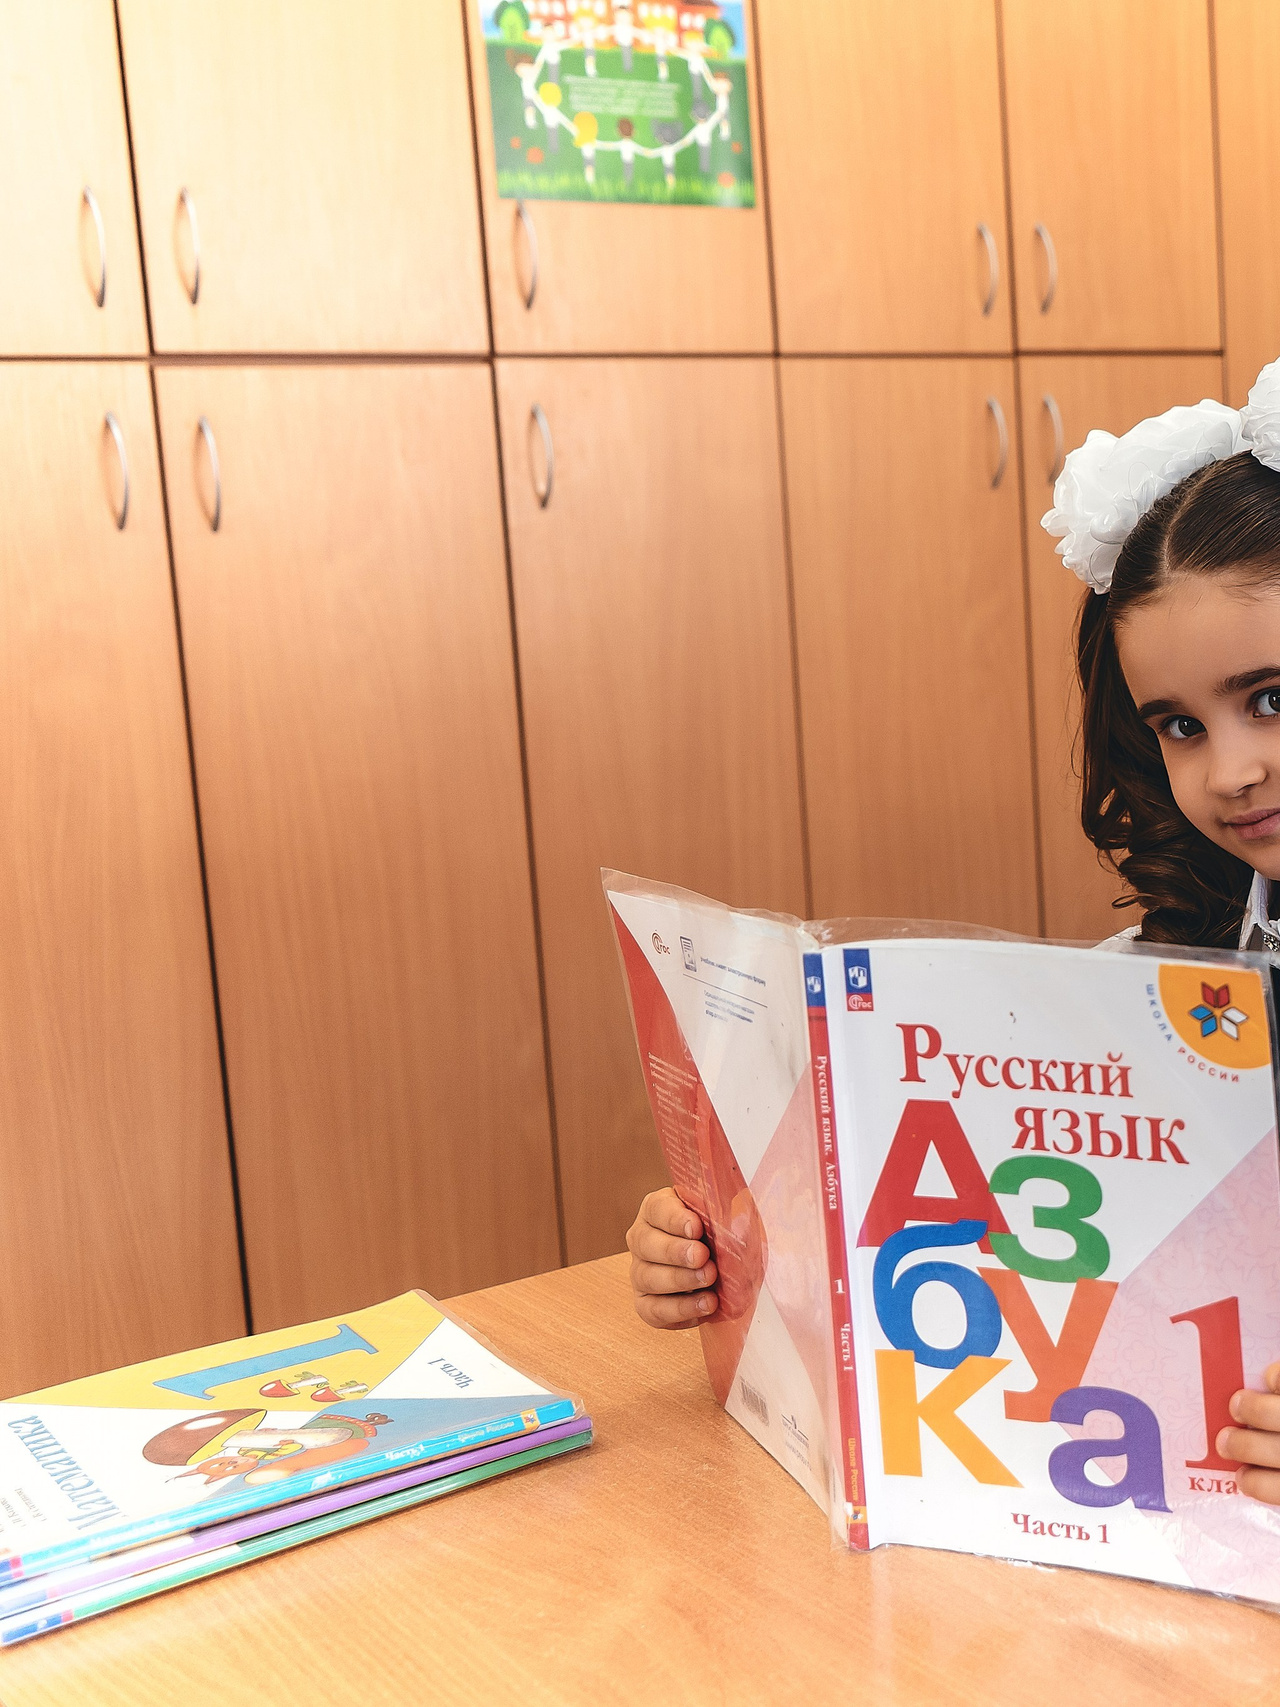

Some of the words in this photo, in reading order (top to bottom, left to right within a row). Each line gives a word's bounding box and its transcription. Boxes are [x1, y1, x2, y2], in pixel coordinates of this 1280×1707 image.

[896, 1022, 1134, 1099] Русский
[1146, 983, 1173, 1041] ШКОЛА
[1177, 1046, 1240, 1083] РОССИИ
[816, 1055, 832, 1114] Русский
[825, 1161, 839, 1210] Азбука
[834, 1279, 846, 1294] 1
[840, 1322, 851, 1361] Часть
[1169, 1295, 1247, 1472] 1
[1188, 1475, 1239, 1495] кла
[1011, 1512, 1091, 1542] Часть
[1098, 1522, 1111, 1544] 1
